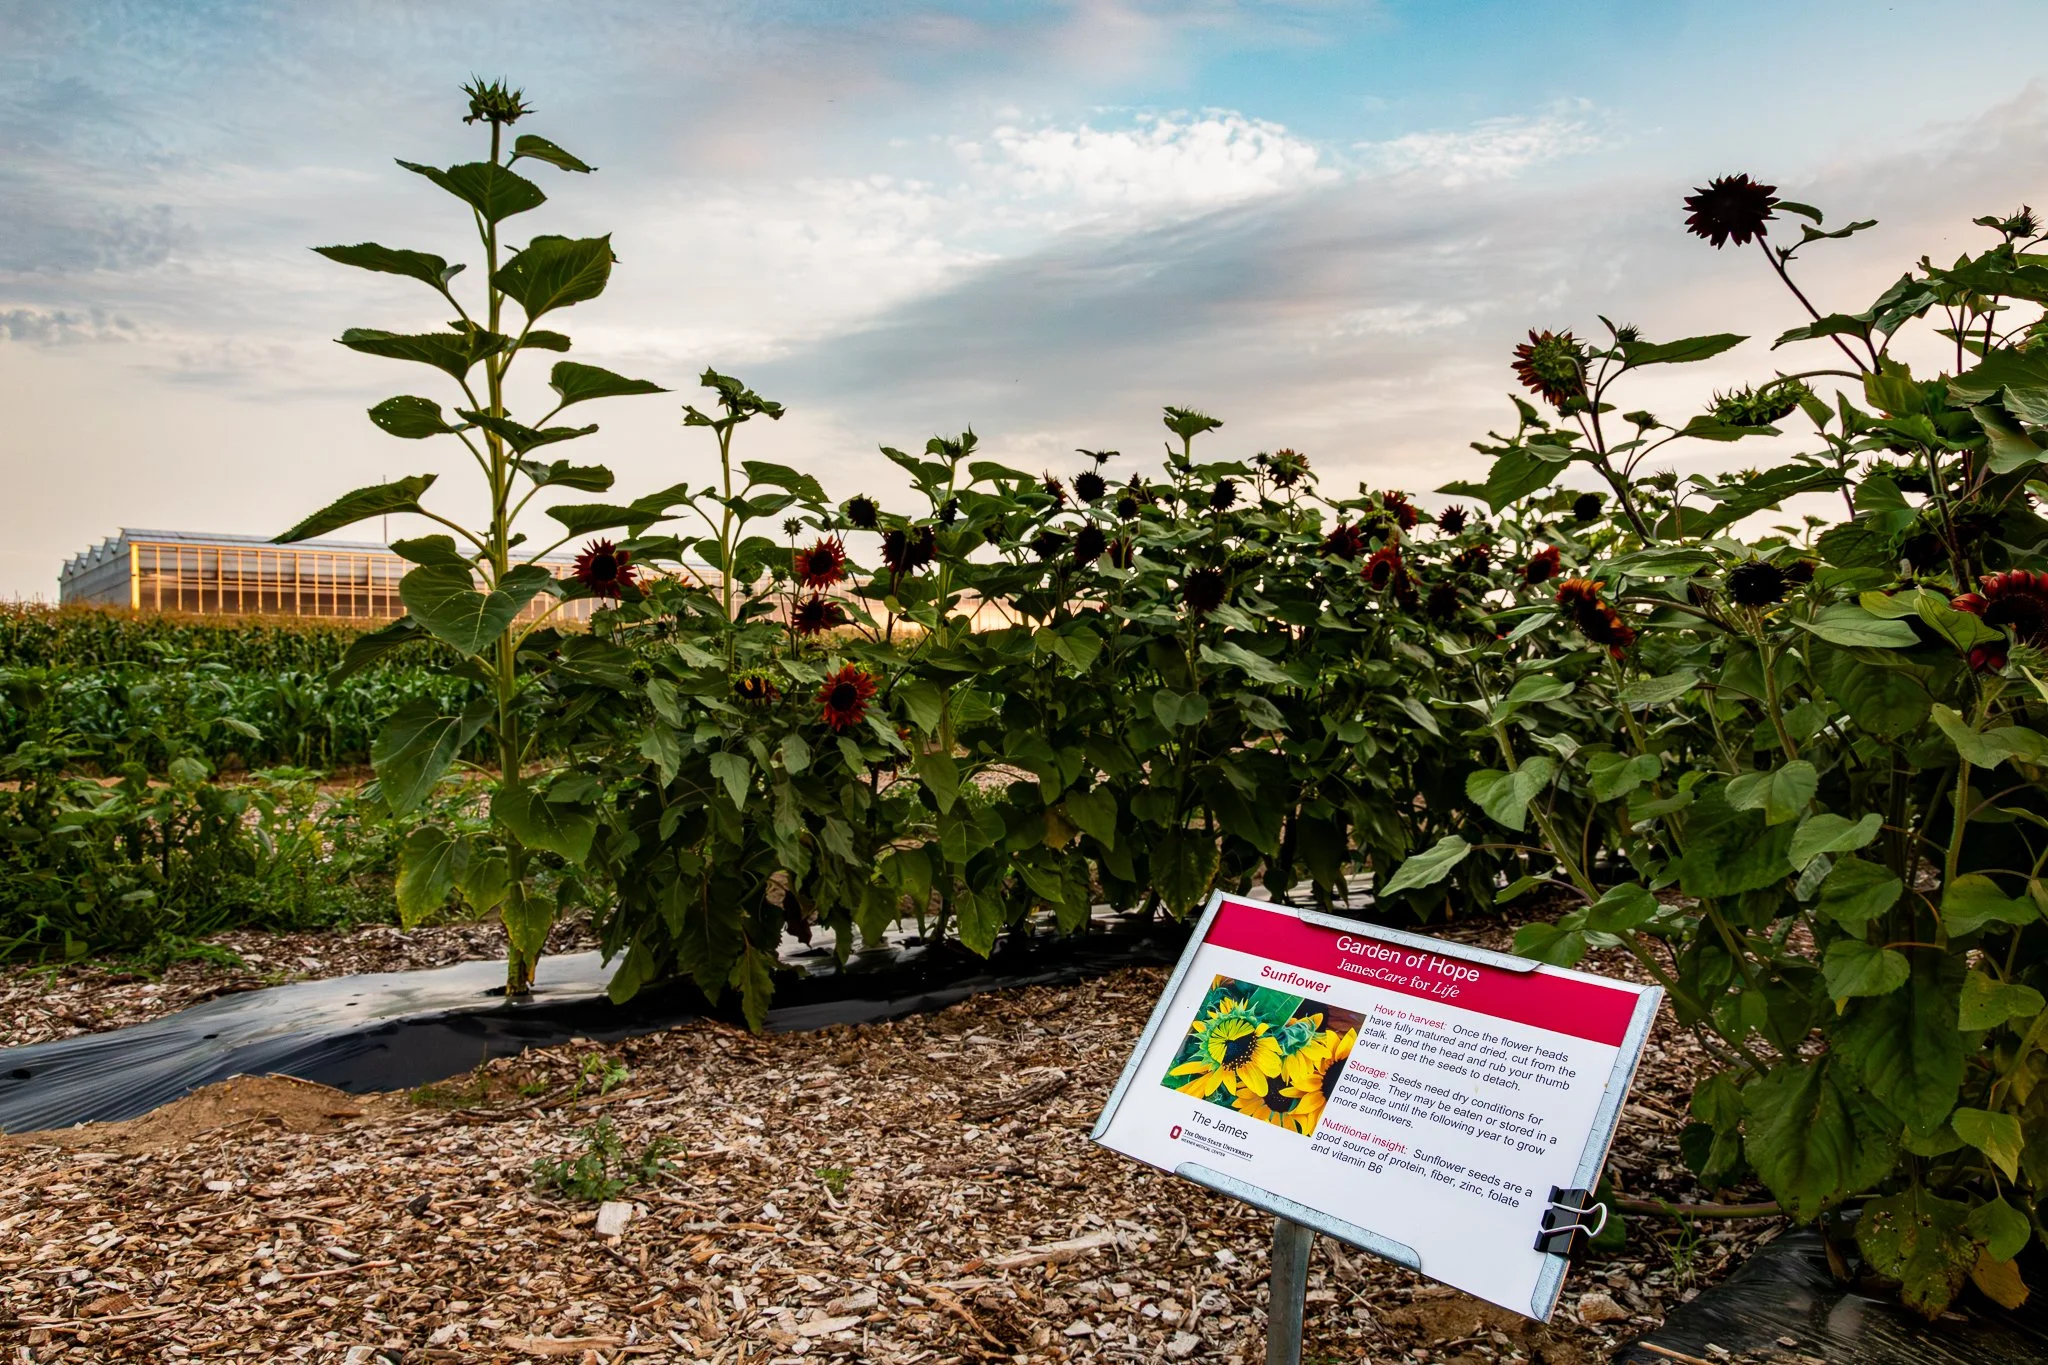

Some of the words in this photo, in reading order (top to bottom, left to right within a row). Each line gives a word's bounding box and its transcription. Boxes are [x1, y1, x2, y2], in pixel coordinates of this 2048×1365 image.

[1260, 965, 1332, 993] Sunflower
[1336, 935, 1401, 964] Garden
[1405, 953, 1428, 969] of
[1427, 956, 1480, 982] Hope
[1337, 958, 1408, 985] JamesCare
[1409, 975, 1431, 991] for
[1431, 981, 1460, 998] Life
[1364, 1027, 1387, 1040] stalk.
[1393, 1033, 1420, 1049] Bend
[1421, 1042, 1437, 1054] the
[1438, 1046, 1466, 1062] head
[1466, 1056, 1488, 1068] and
[1488, 1062, 1507, 1073] rub
[1507, 1067, 1534, 1080] your
[1535, 1073, 1570, 1091] thumb
[1369, 1014, 1393, 1028] have
[1393, 1021, 1414, 1036] fully
[1415, 1029, 1457, 1046] matured
[1457, 1040, 1479, 1052] and
[1479, 1045, 1508, 1061] dried,
[1511, 1055, 1529, 1066] cut
[1530, 1058, 1556, 1073] from
[1558, 1065, 1576, 1078] the
[1373, 1003, 1396, 1016] How
[1397, 1010, 1407, 1019] to
[1408, 1012, 1447, 1030] harvest:
[1452, 1024, 1480, 1039] Once
[1481, 1032, 1499, 1044] the
[1500, 1036, 1534, 1053] flower
[1534, 1045, 1569, 1063] heads
[1349, 1060, 1389, 1079] Storage:
[1390, 1072, 1422, 1090] Seeds
[1424, 1084, 1451, 1098] need
[1451, 1091, 1470, 1105] dry
[1470, 1098, 1525, 1121] conditions
[1527, 1113, 1544, 1126] for
[1359, 1039, 1381, 1050] over
[1381, 1043, 1389, 1053] it
[1389, 1046, 1400, 1056] to
[1400, 1051, 1418, 1062] get
[1419, 1054, 1436, 1066] the
[1436, 1061, 1468, 1076] seeds
[1469, 1069, 1481, 1079] to
[1482, 1073, 1520, 1091] detach.
[1192, 1110, 1212, 1127] The
[1212, 1119, 1249, 1140] James
[1332, 1096, 1358, 1110] more
[1359, 1104, 1413, 1129] sunflowers.
[1338, 1085, 1360, 1097] cool
[1358, 1091, 1387, 1105] place
[1388, 1100, 1410, 1113] until
[1411, 1106, 1428, 1119] the
[1429, 1111, 1475, 1136] following
[1475, 1128, 1502, 1142] year
[1503, 1135, 1515, 1146] to
[1516, 1141, 1546, 1156] grow
[1343, 1073, 1381, 1091] storage.
[1388, 1084, 1413, 1101] They
[1413, 1095, 1437, 1109] may
[1437, 1100, 1451, 1112] be
[1453, 1107, 1483, 1122] eaten
[1485, 1117, 1498, 1126] or
[1499, 1121, 1535, 1138] stored
[1536, 1130, 1547, 1142] in
[1549, 1136, 1557, 1145] a
[1310, 1143, 1331, 1155] and
[1332, 1150, 1366, 1168] vitamin
[1367, 1161, 1383, 1174] B6
[1315, 1131, 1342, 1145] good
[1342, 1140, 1376, 1158] source
[1377, 1152, 1390, 1162] of
[1388, 1156, 1427, 1177] protein,
[1430, 1169, 1456, 1188] fiber,
[1459, 1181, 1484, 1198] zinc,
[1487, 1188, 1520, 1208] folate
[1322, 1117, 1372, 1141] Nutritional
[1371, 1134, 1408, 1155] insight:
[1413, 1148, 1467, 1174] Sunflower
[1467, 1169, 1501, 1187] seeds
[1502, 1181, 1523, 1194] are
[1524, 1188, 1533, 1198] a
